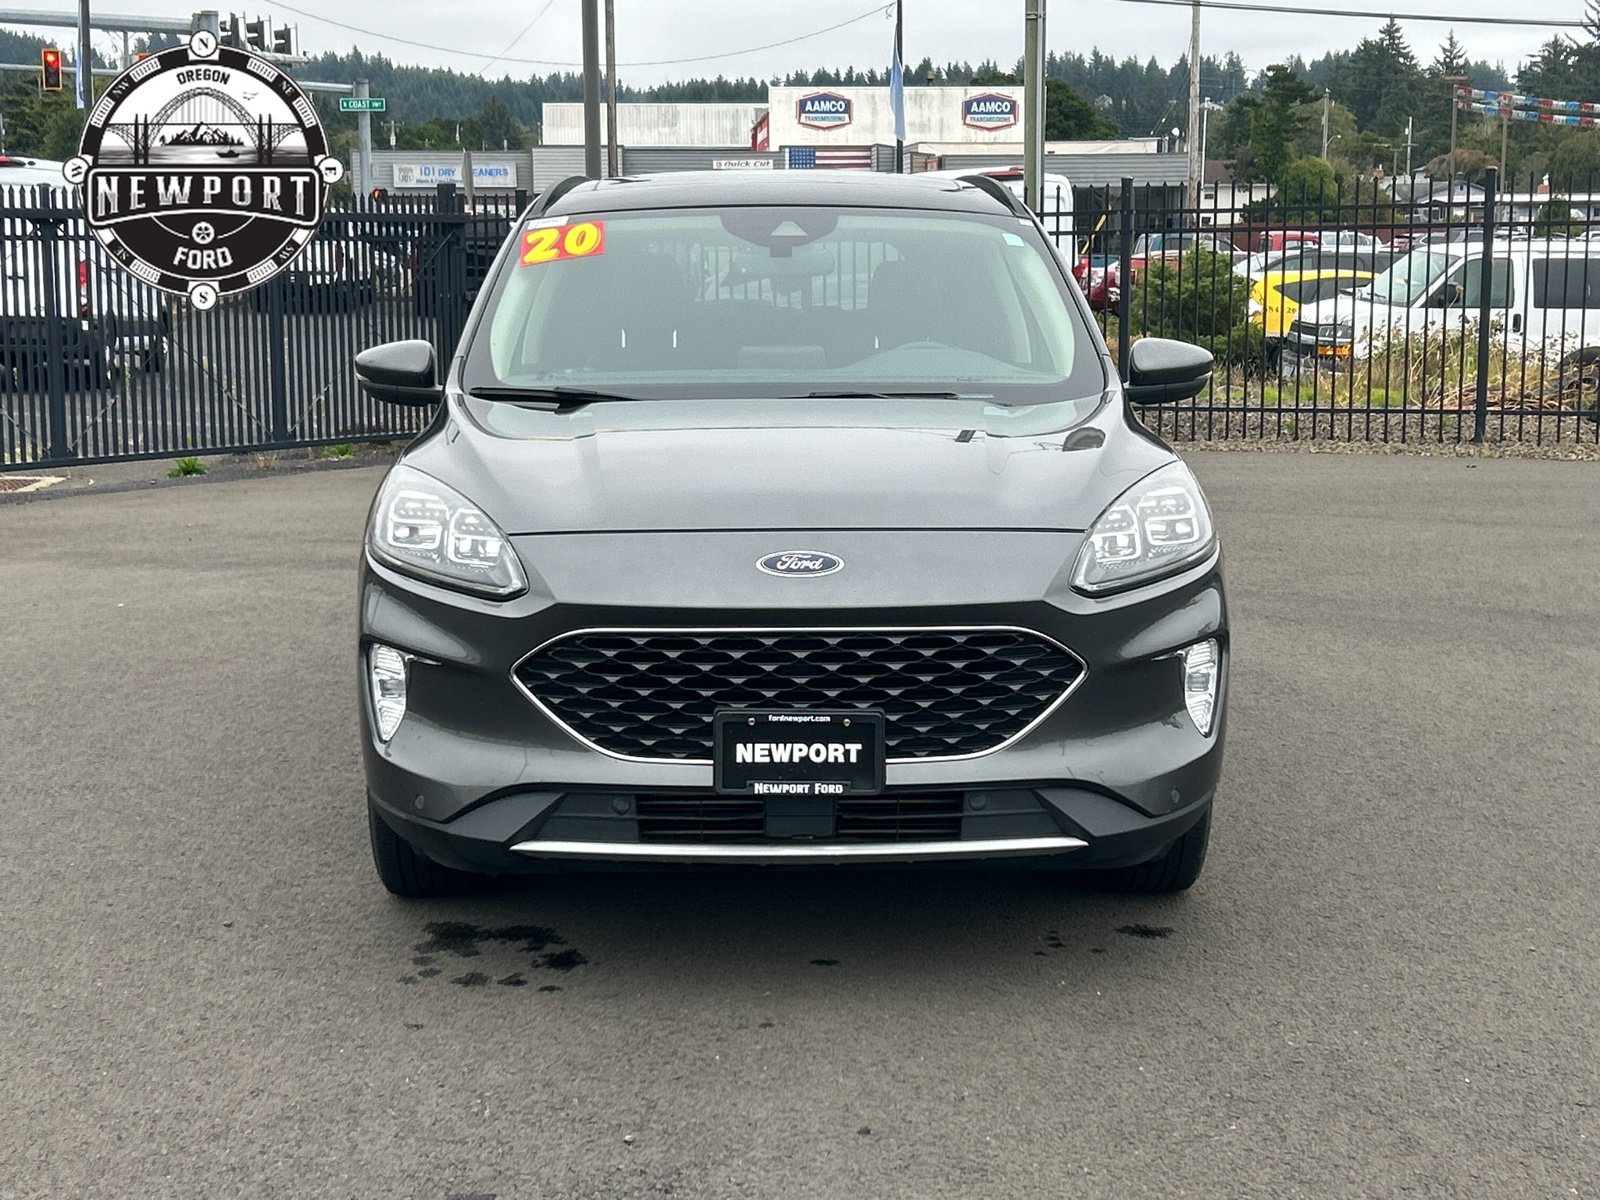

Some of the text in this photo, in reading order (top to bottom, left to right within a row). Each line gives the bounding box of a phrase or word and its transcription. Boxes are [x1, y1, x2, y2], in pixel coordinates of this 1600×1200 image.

[349, 101, 370, 109] COAST
[805, 101, 846, 112] AAMCO
[971, 102, 1011, 113] AAMCO
[724, 160, 770, 168] Quick Cut
[420, 167, 509, 177] 101 DRY EANERS
[524, 223, 601, 263] 20
[776, 554, 824, 570] Ford
[768, 714, 831, 723] fordnewport.com
[735, 743, 862, 763] NEWPORT
